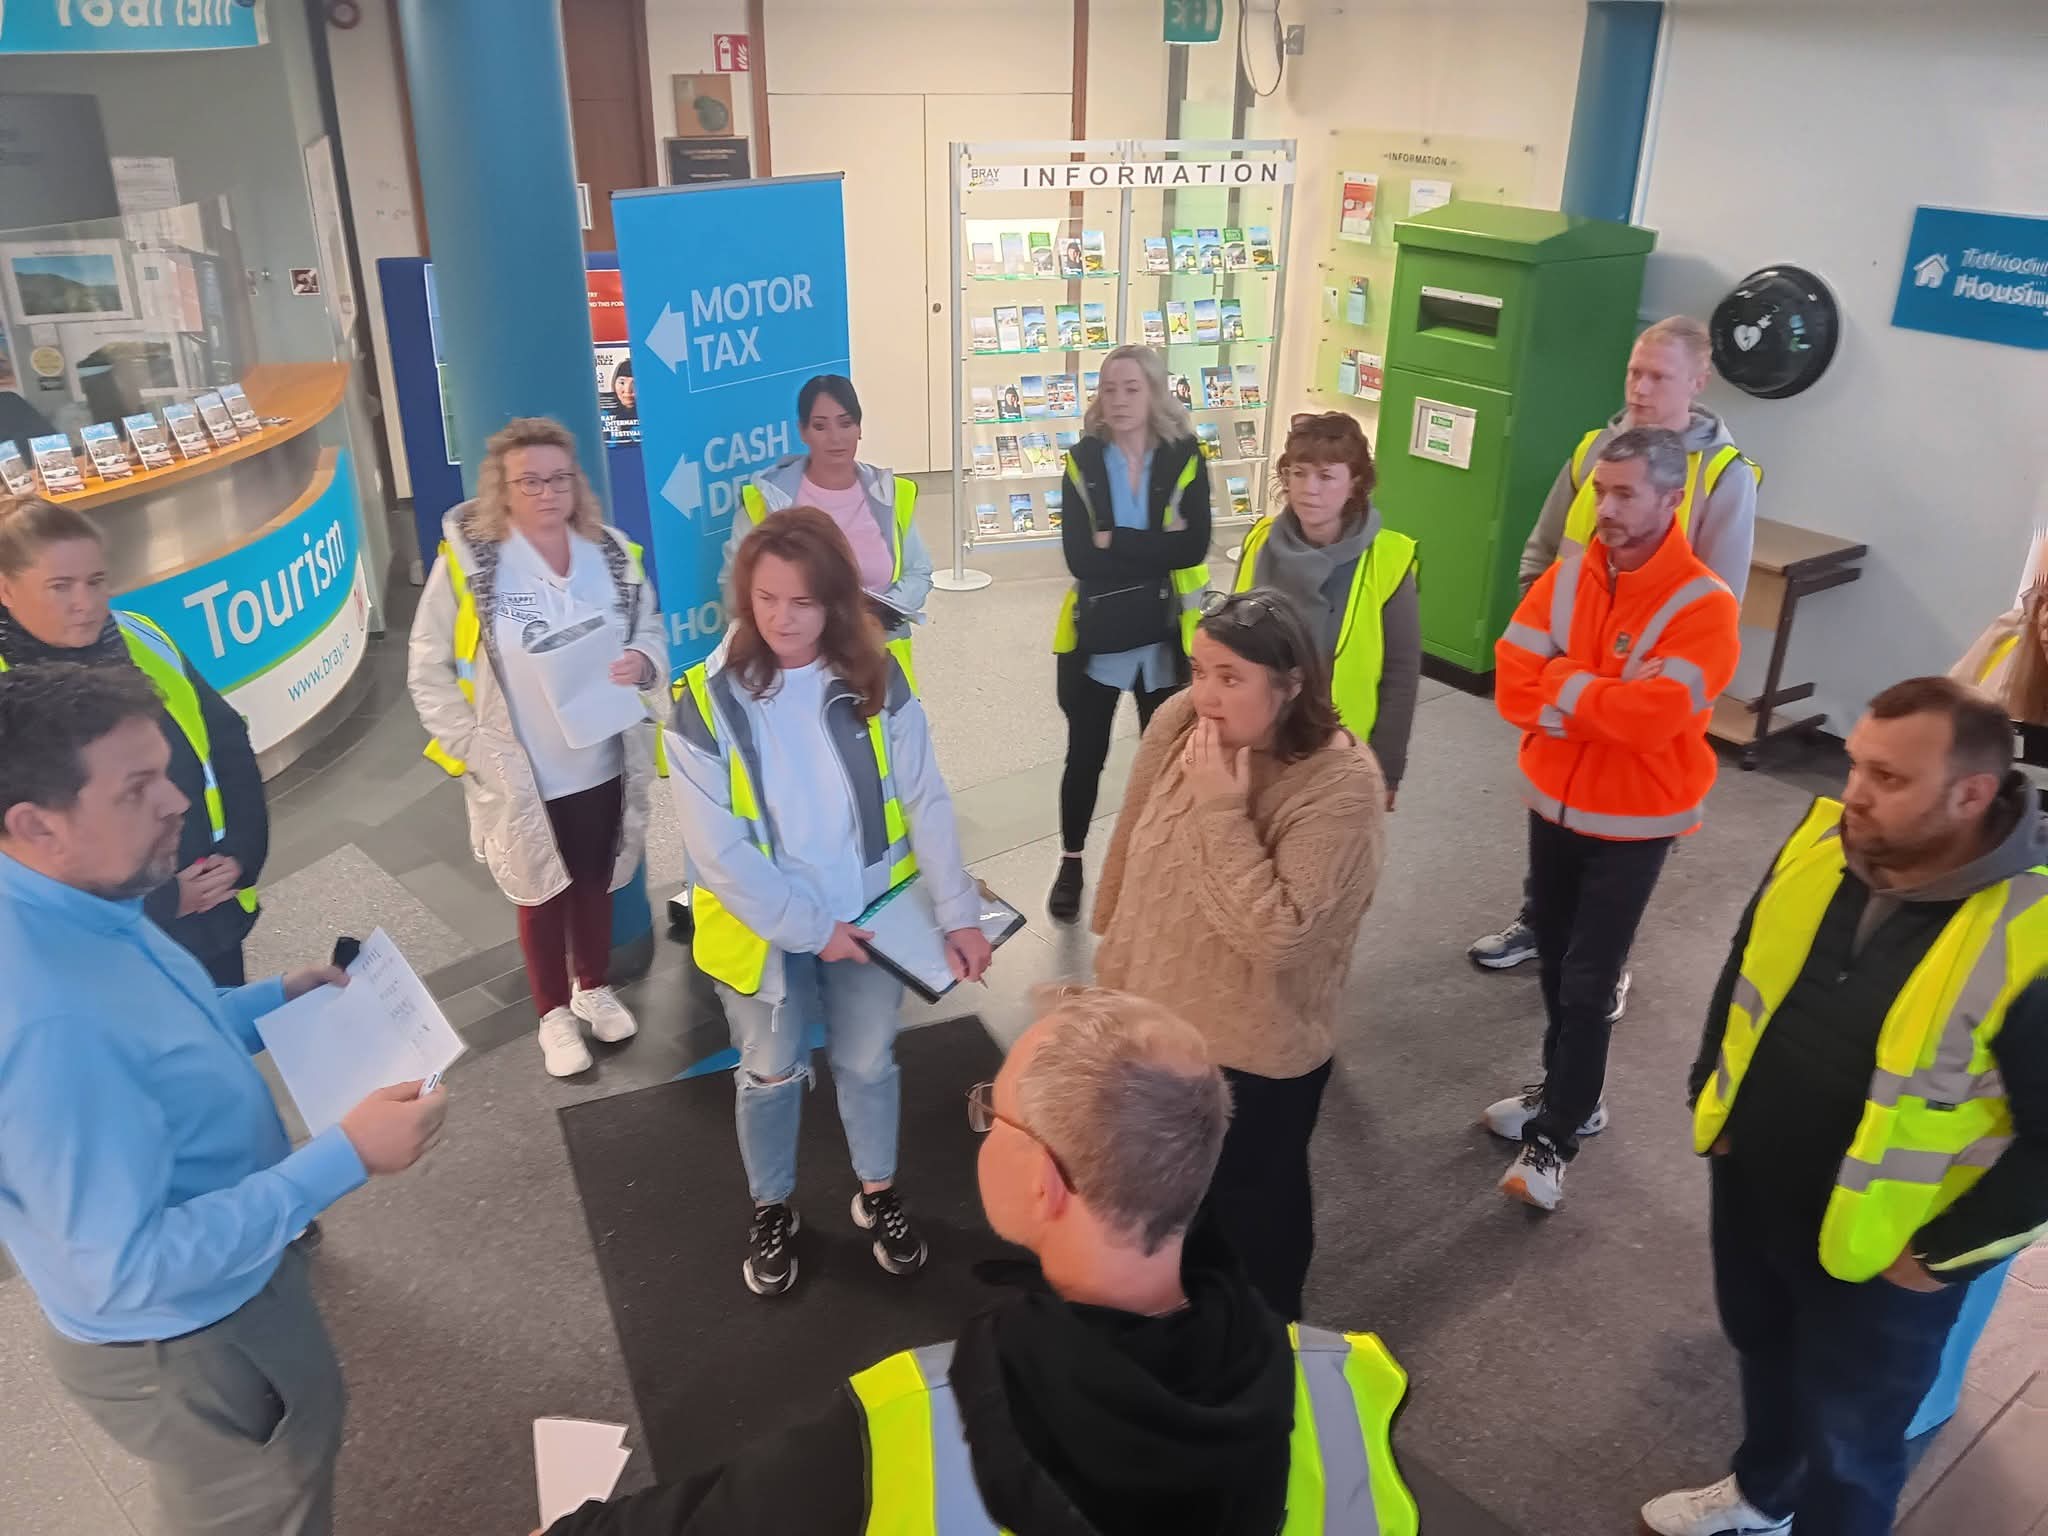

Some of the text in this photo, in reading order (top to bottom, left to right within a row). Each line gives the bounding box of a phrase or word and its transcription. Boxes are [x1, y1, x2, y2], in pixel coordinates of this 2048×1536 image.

[970, 167, 1000, 179] BRAY
[1023, 163, 1278, 187] INFORMATION
[1388, 151, 1448, 167] INFORMATION
[690, 273, 814, 328] MOTOR
[693, 326, 762, 374] TAX
[704, 420, 790, 473] CASH
[183, 519, 346, 659] Tourism
[288, 633, 351, 701] www.bray.ie
